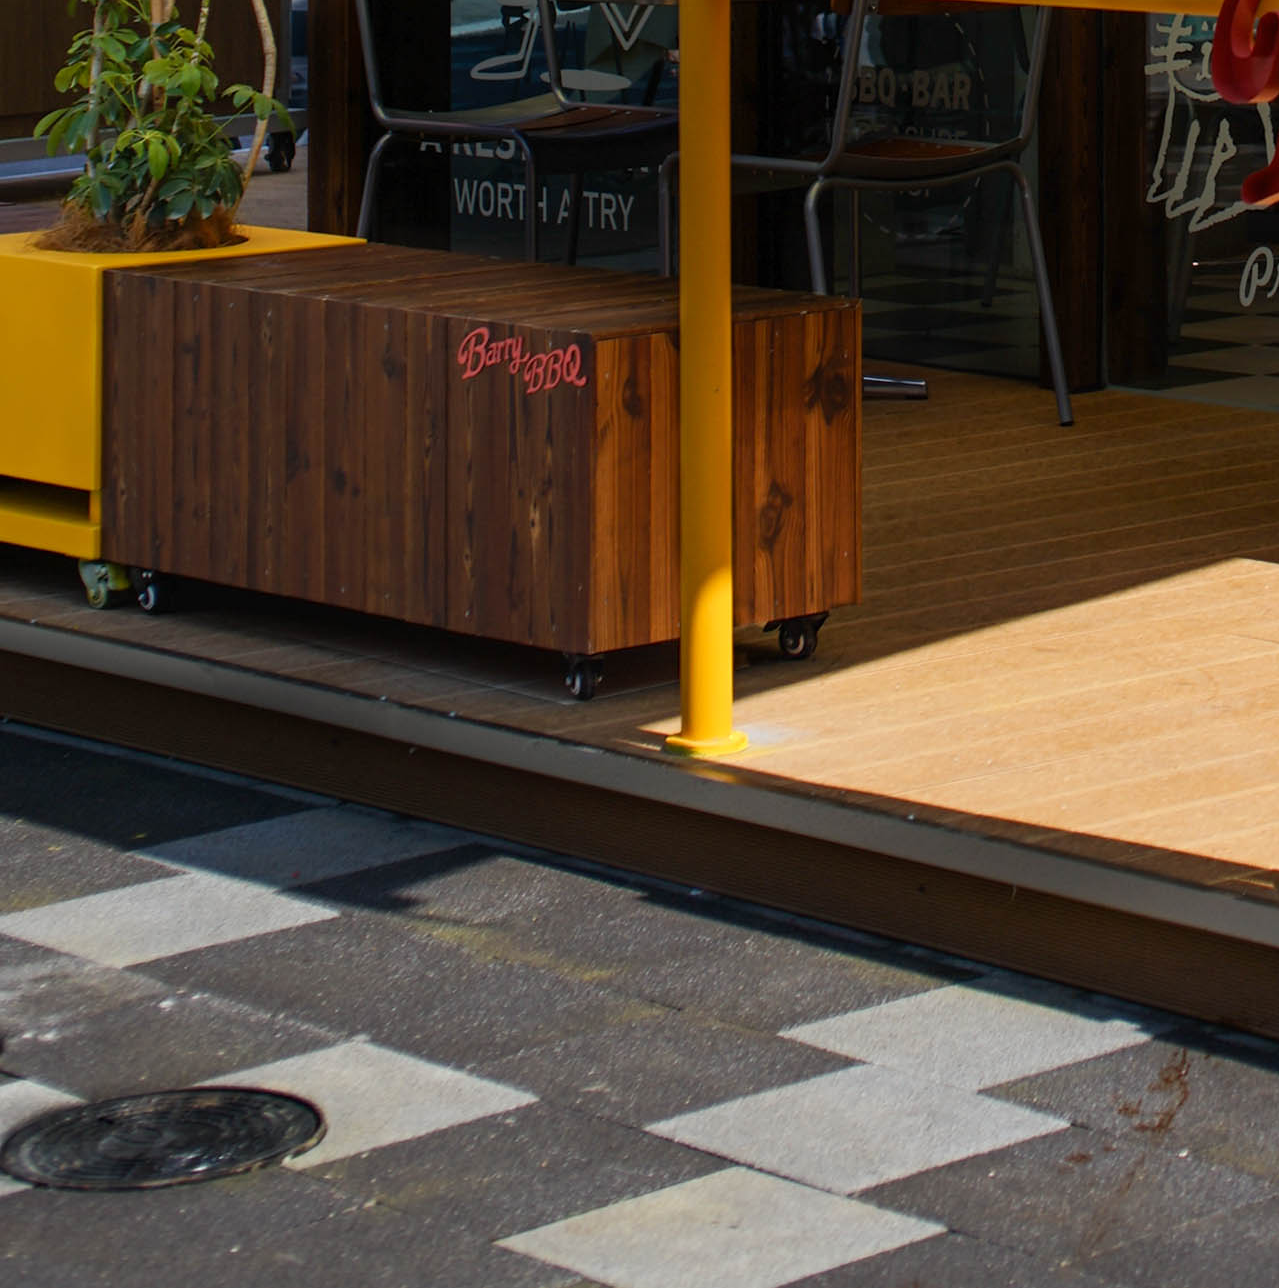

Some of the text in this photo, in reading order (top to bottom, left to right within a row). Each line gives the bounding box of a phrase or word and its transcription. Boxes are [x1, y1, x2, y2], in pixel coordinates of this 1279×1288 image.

[912, 70, 972, 111] BAR
[453, 178, 547, 224] WORTH
[583, 191, 635, 232] TRY
[456, 326, 588, 395] Barry BBQ
